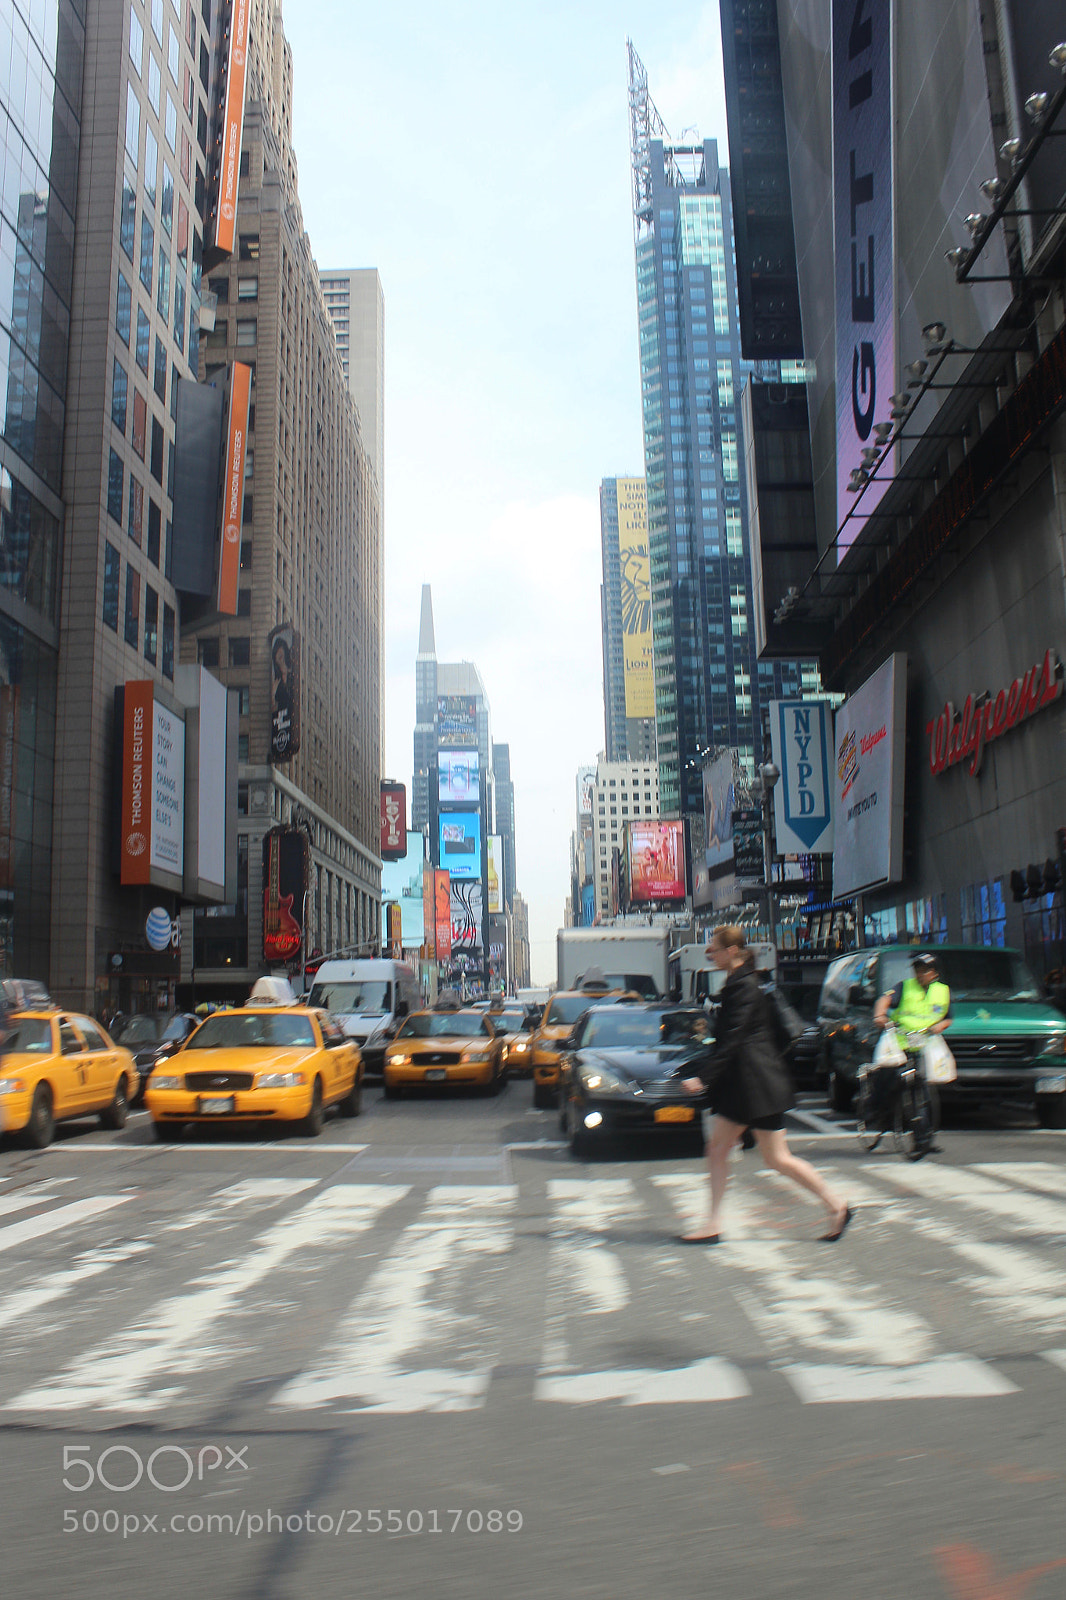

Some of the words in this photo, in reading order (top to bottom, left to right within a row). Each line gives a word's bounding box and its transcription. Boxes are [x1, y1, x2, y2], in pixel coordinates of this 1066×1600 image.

[851, 149, 876, 442] GET
[232, 429, 242, 473] REUTERS
[229, 472, 240, 520] THOMSON
[157, 714, 171, 733] YOUR
[925, 647, 1062, 778] Walgreens
[133, 706, 145, 763] REUTERS
[157, 733, 174, 753] STORY
[860, 724, 887, 756] Walgreens
[156, 752, 168, 770] CAN
[793, 708, 816, 815] NYPD
[131, 764, 144, 827] THOMSON
[155, 789, 179, 812] SOMEONE
[156, 771, 176, 793] CHANGE
[155, 808, 172, 828] ELSE'S
